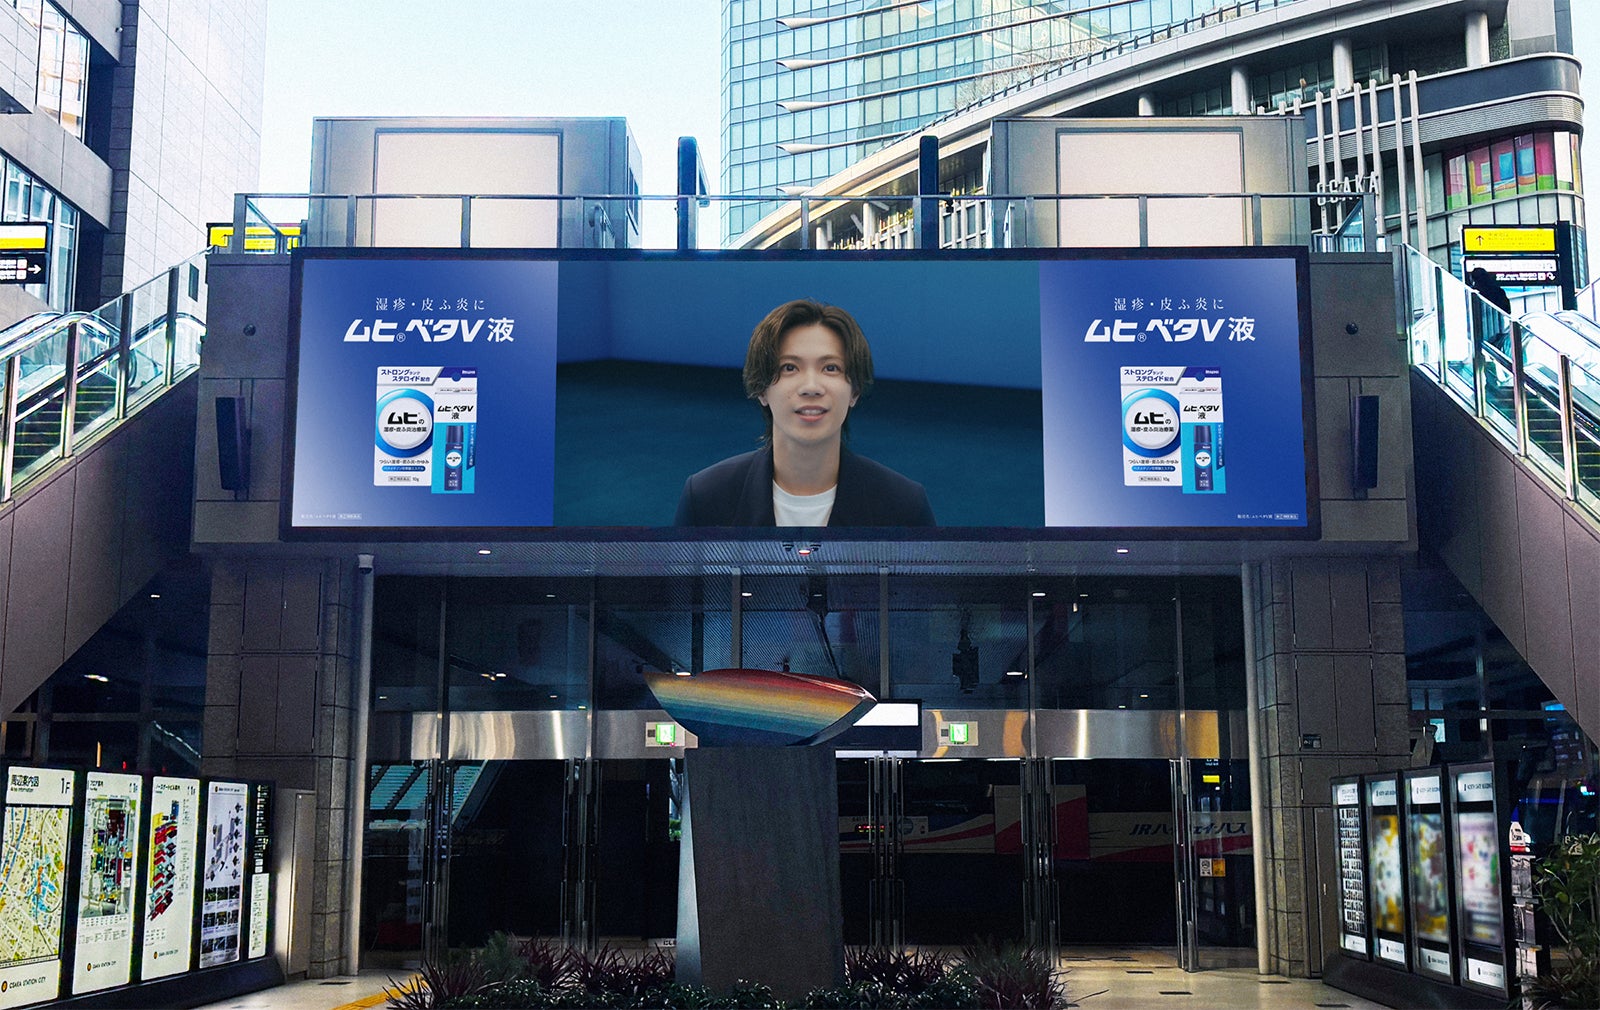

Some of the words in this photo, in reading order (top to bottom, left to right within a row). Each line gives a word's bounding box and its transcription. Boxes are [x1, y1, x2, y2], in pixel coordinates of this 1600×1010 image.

[1316, 171, 1380, 206] OSAKA
[376, 297, 485, 311] 湿疹・皮ふ炎に
[1114, 297, 1224, 311] 湿疹・皮ふ炎に
